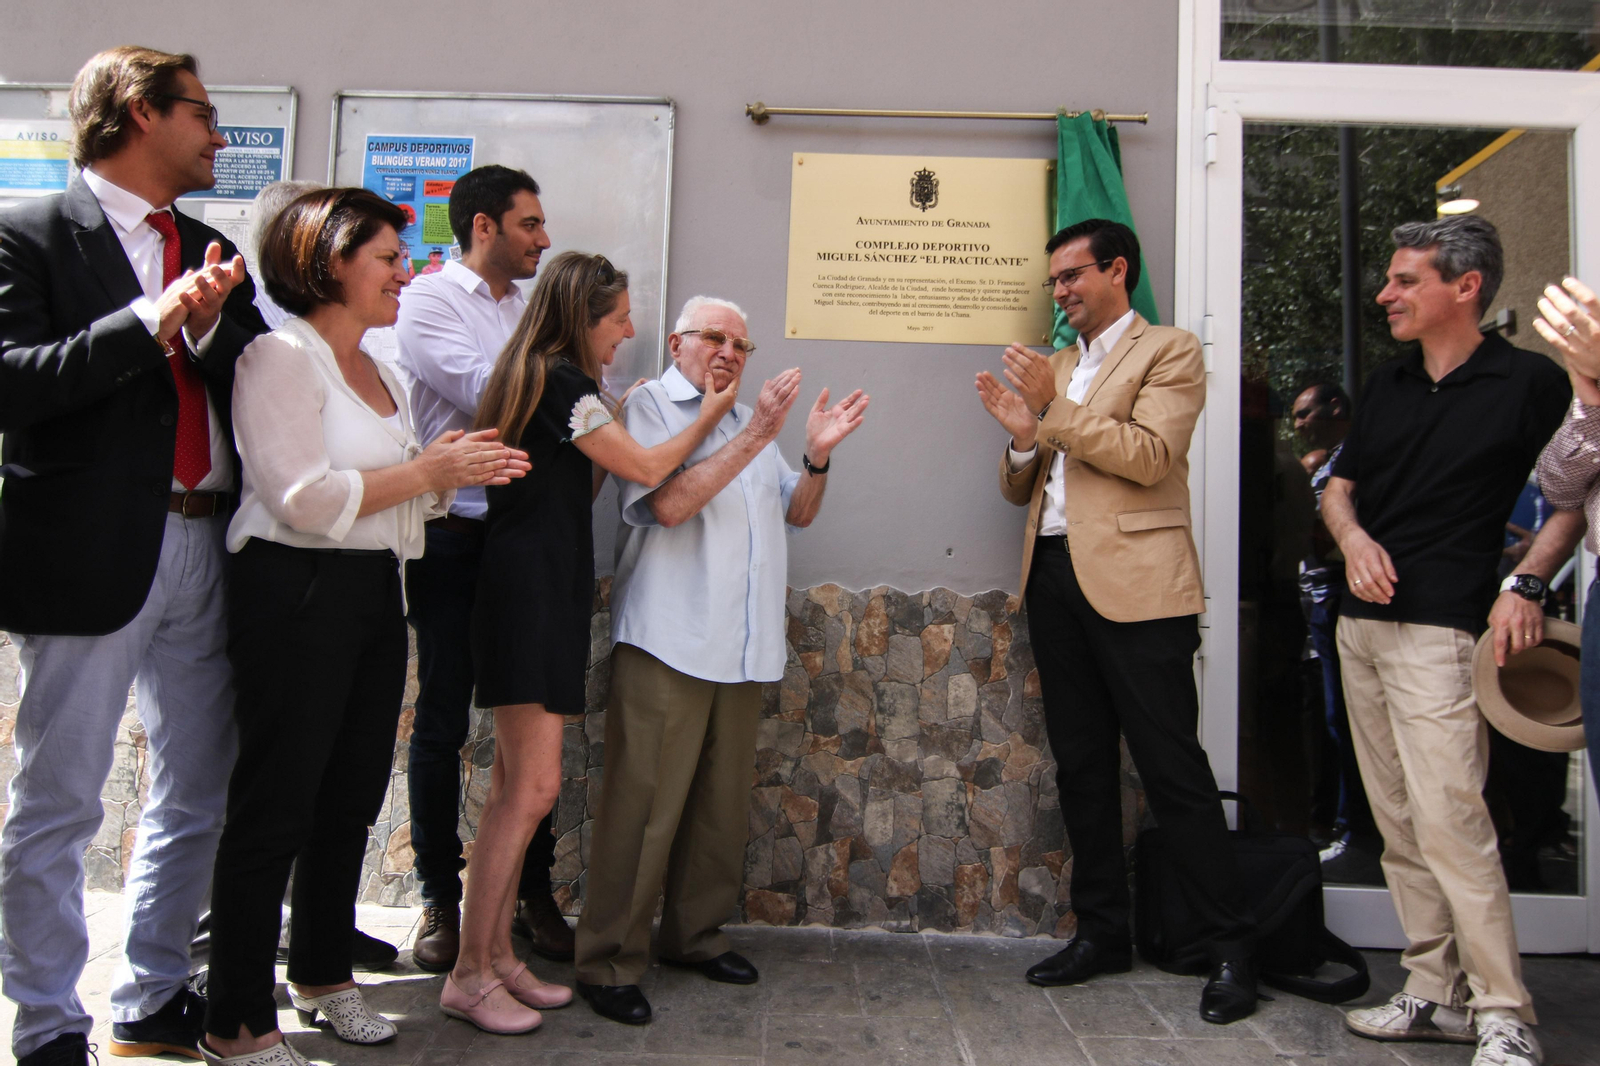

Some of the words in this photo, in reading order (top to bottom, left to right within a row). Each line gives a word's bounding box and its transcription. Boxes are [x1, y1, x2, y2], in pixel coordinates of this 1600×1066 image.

[17, 132, 58, 141] AVISO
[223, 131, 273, 145] AVISO
[368, 142, 408, 153] CAMPUS
[410, 142, 471, 154] DEPORTIVOS
[372, 154, 414, 167] BILINGÜES
[415, 156, 447, 168] VERANO
[448, 158, 468, 168] 2017
[856, 240, 919, 250] COMPLEJO
[922, 242, 990, 252] DEPORTIVO
[816, 252, 862, 262] MIGUEL
[864, 252, 918, 263] SÁNCHEZ
[920, 256, 940, 264] “EL
[942, 256, 1028, 266] PRACTICANTE”
